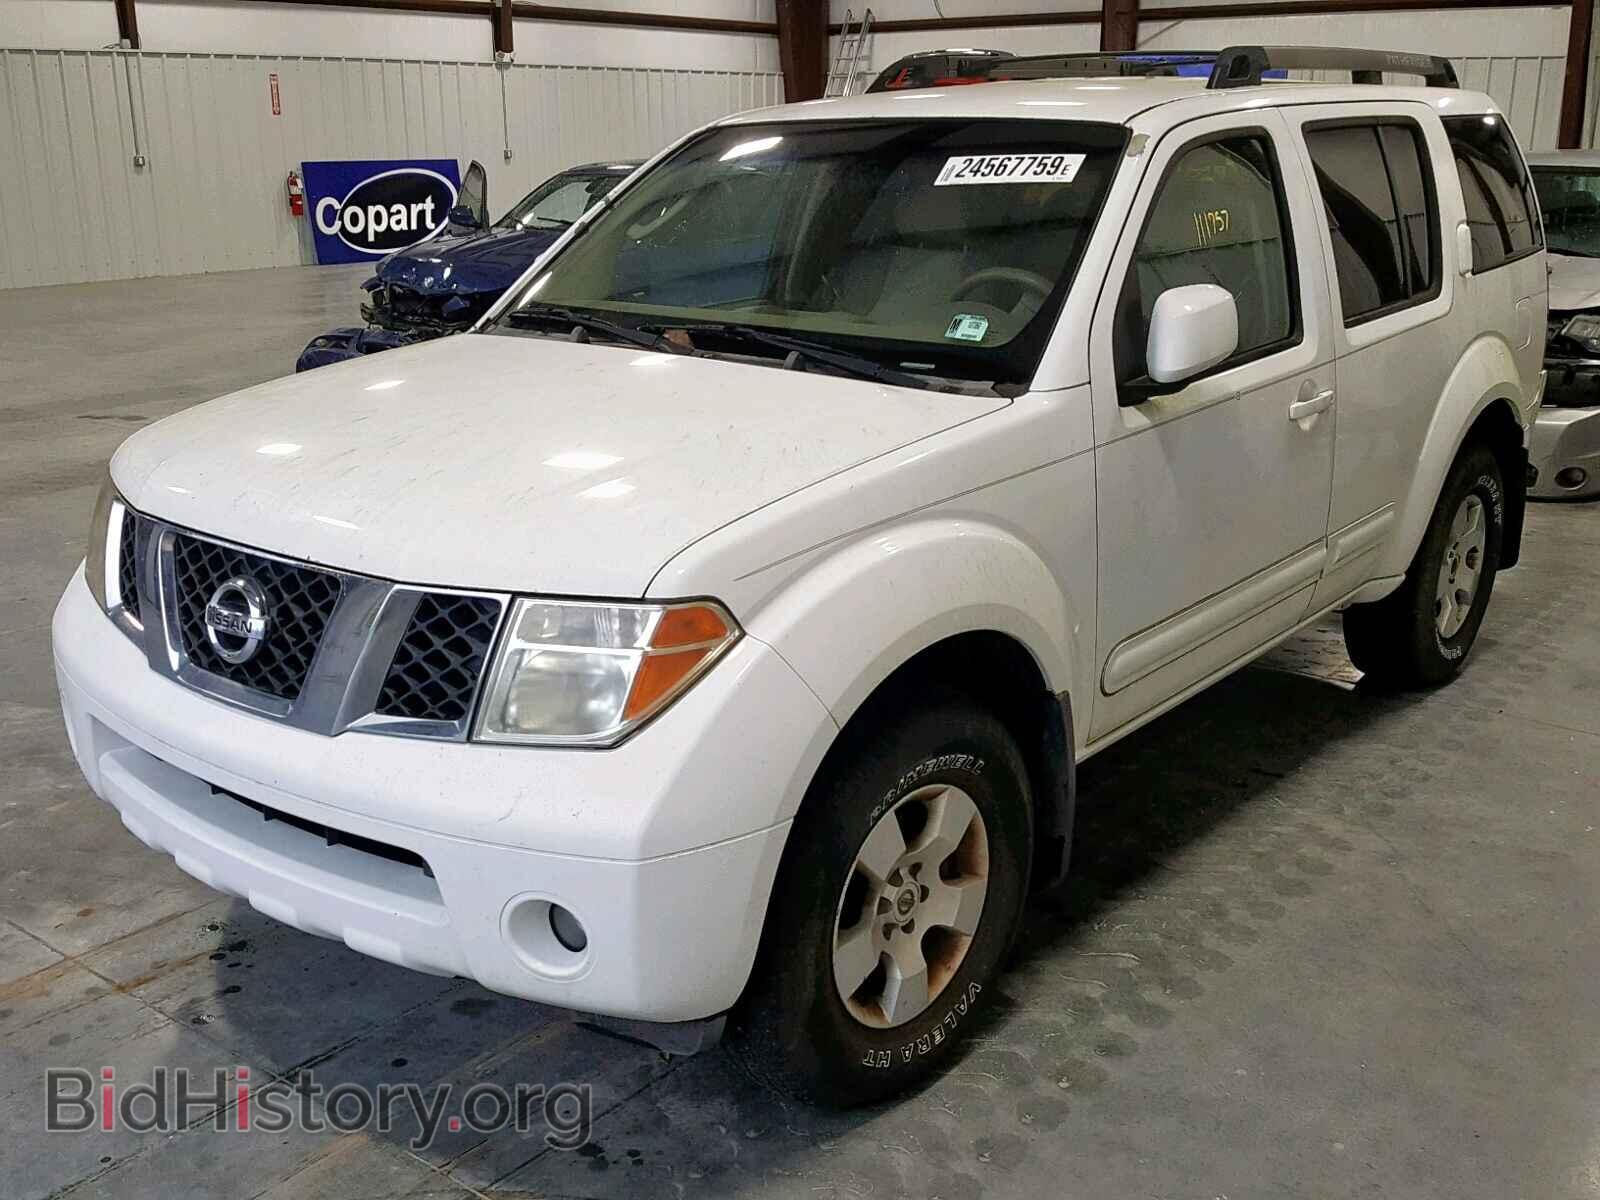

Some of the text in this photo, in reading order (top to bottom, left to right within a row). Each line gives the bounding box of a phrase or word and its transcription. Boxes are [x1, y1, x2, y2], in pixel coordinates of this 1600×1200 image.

[315, 194, 436, 242] Copart
[207, 604, 253, 634] NISSAN
[862, 982, 982, 1068] VALERA HT
